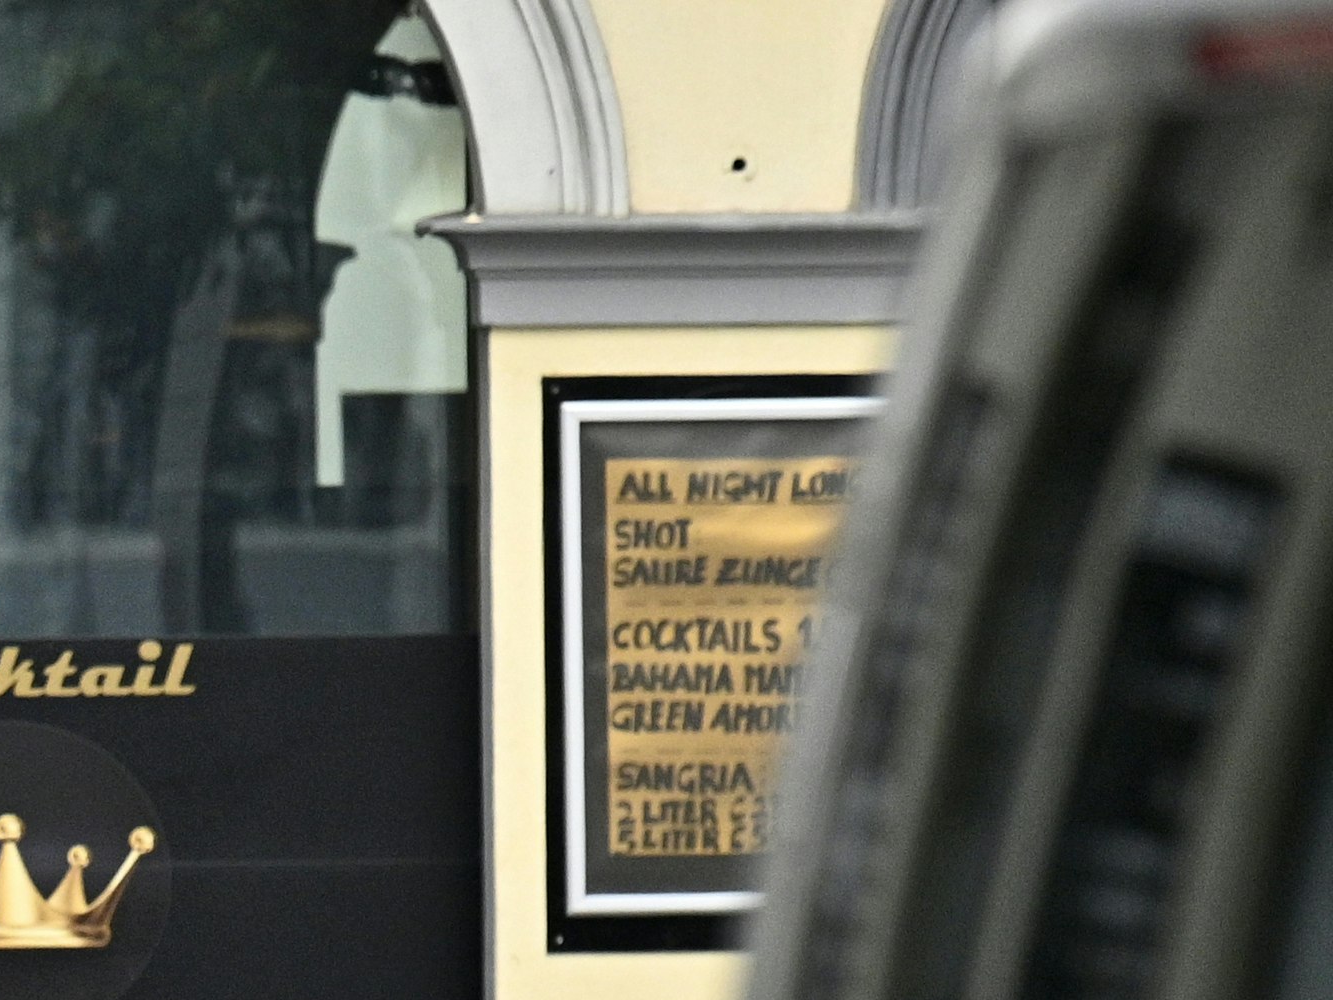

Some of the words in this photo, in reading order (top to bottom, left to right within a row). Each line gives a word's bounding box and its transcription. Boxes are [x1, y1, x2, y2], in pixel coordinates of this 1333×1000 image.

[619, 471, 674, 500] ALL
[687, 470, 783, 502] NIGHT
[613, 517, 692, 550] SHOT
[612, 555, 709, 588] SAURE
[612, 617, 782, 653] COCKTAILS
[612, 663, 734, 695] BAHAMA
[611, 699, 706, 733] GREEN
[616, 762, 755, 793] SANGRIA
[642, 798, 718, 825] LITER
[642, 828, 719, 852] LITER
